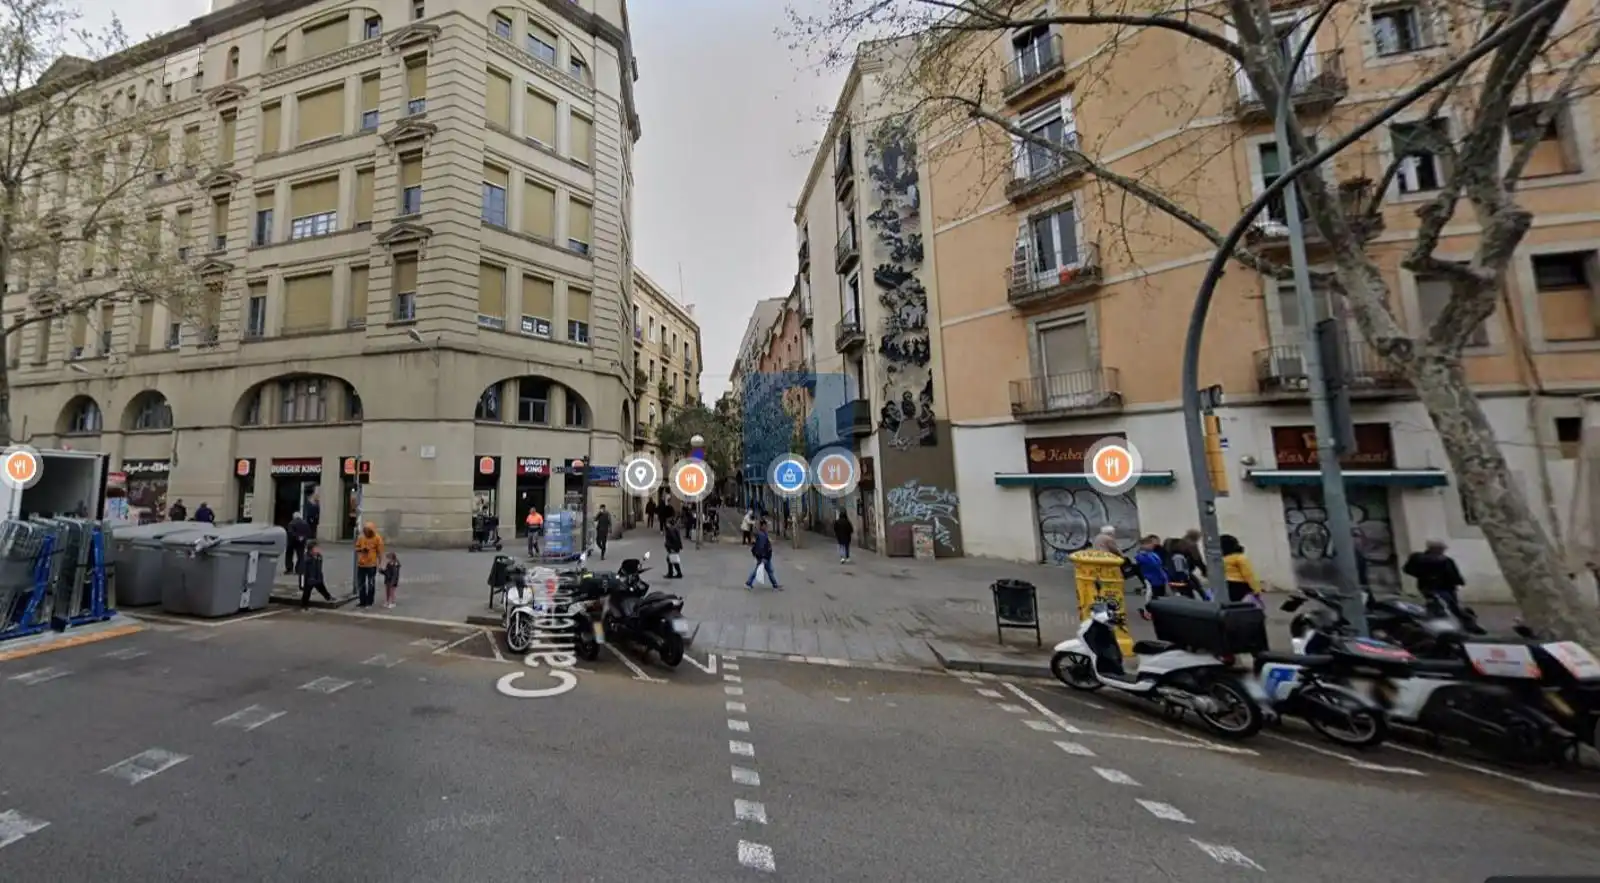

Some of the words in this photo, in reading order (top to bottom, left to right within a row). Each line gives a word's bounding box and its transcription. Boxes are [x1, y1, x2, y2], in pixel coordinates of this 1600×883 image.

[519, 458, 547, 467] BURGER
[271, 464, 300, 474] BURGER
[301, 463, 321, 474] KING
[525, 466, 543, 474] KING
